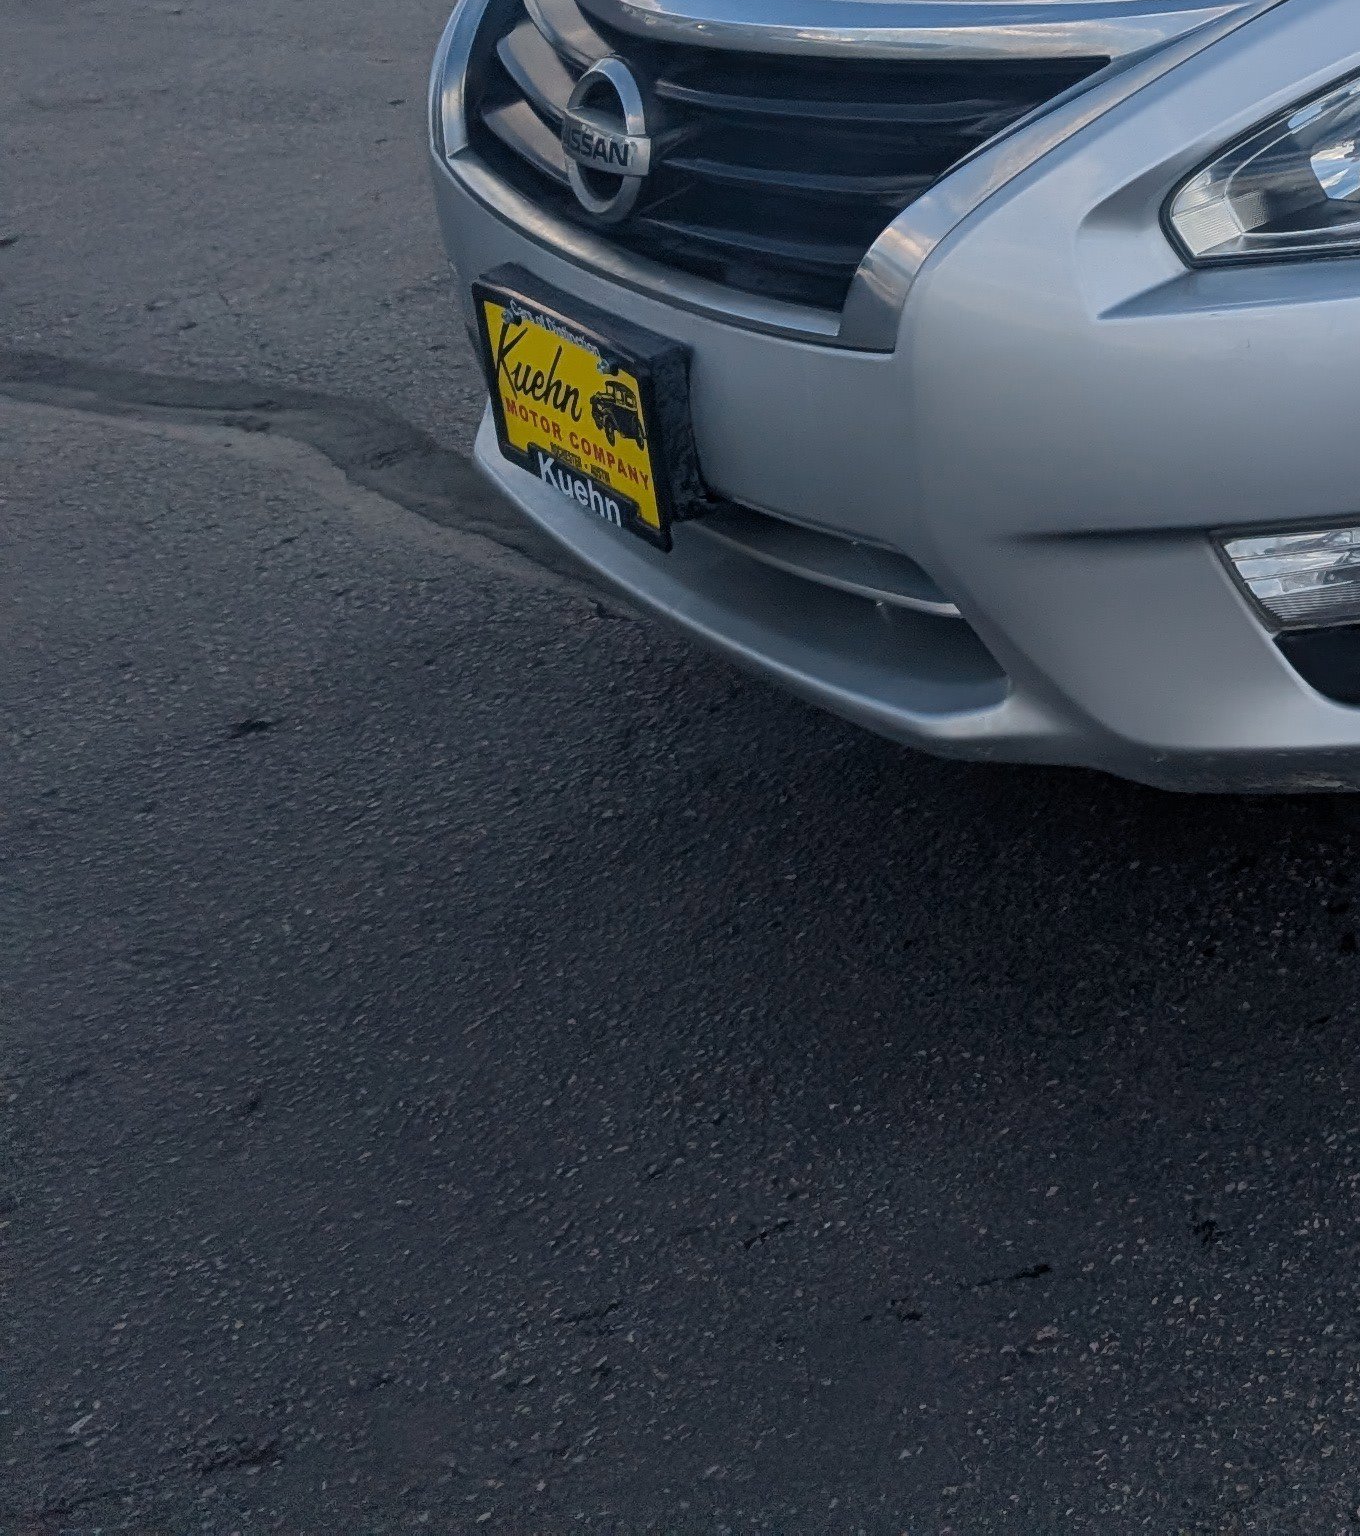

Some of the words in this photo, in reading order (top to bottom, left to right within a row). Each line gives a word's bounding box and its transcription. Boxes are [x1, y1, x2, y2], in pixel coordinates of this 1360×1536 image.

[496, 321, 583, 423] Kuehn
[504, 399, 562, 442] MOTOR
[569, 431, 651, 491] COMPANY
[538, 451, 622, 527] Kuehn
